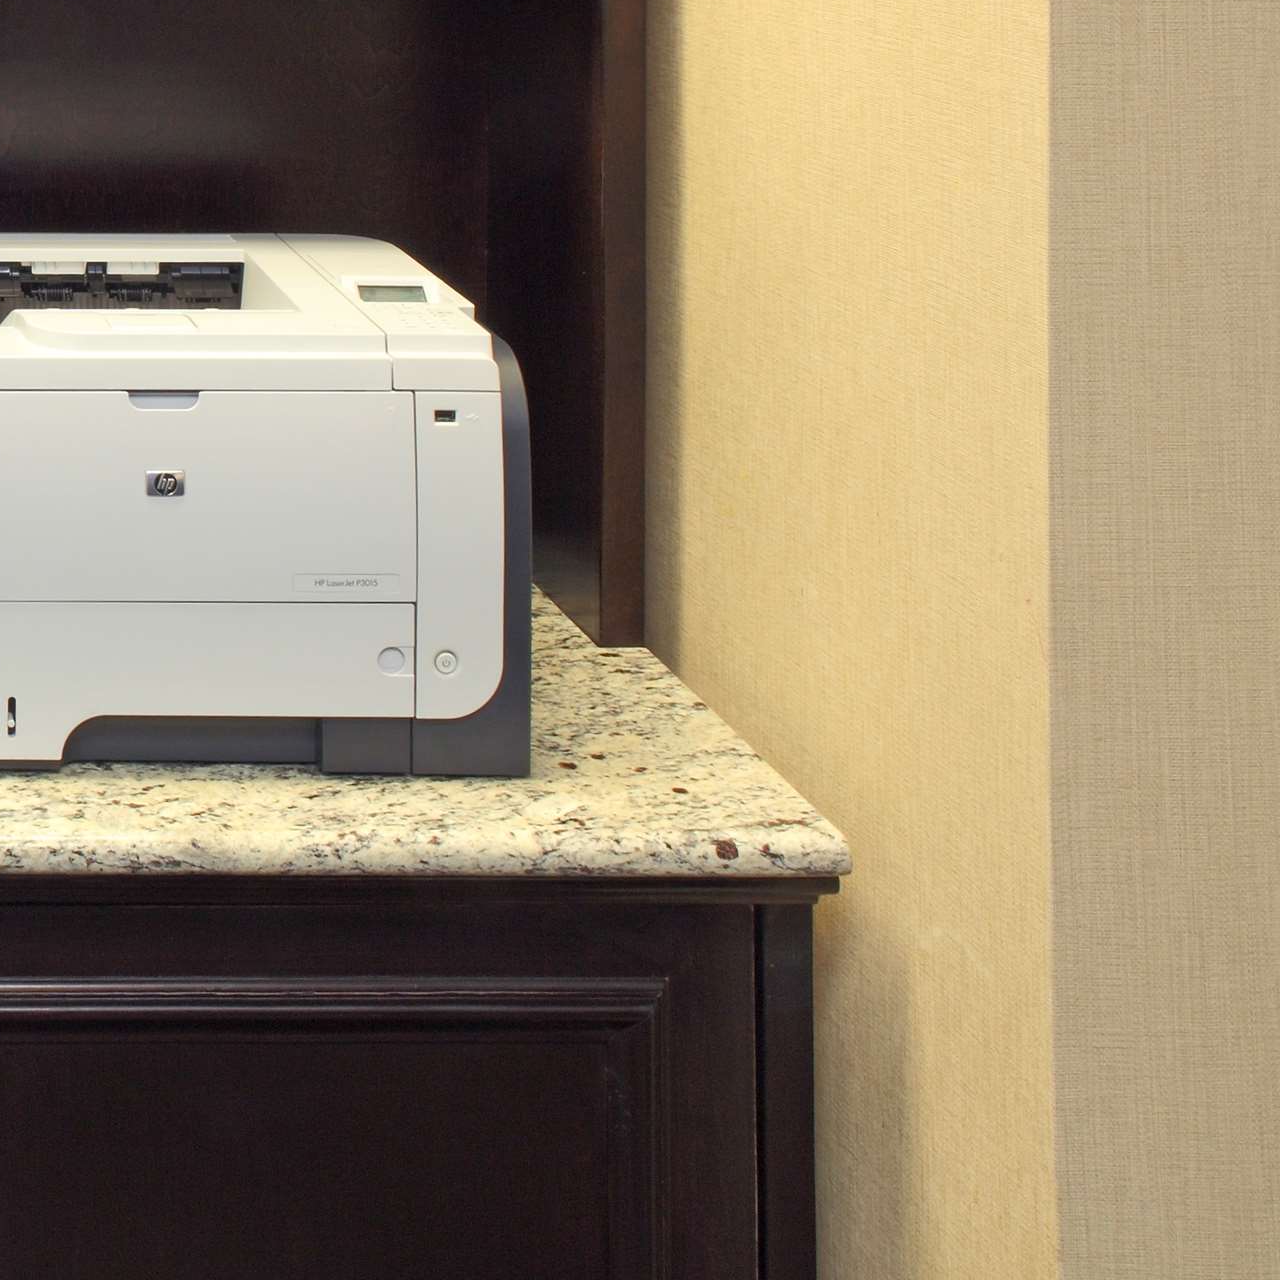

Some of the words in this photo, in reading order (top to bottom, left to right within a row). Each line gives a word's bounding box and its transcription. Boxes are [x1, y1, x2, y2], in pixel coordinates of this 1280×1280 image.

[314, 578, 325, 587] HP
[326, 578, 355, 587] LaserJet
[355, 578, 378, 587] P3015
